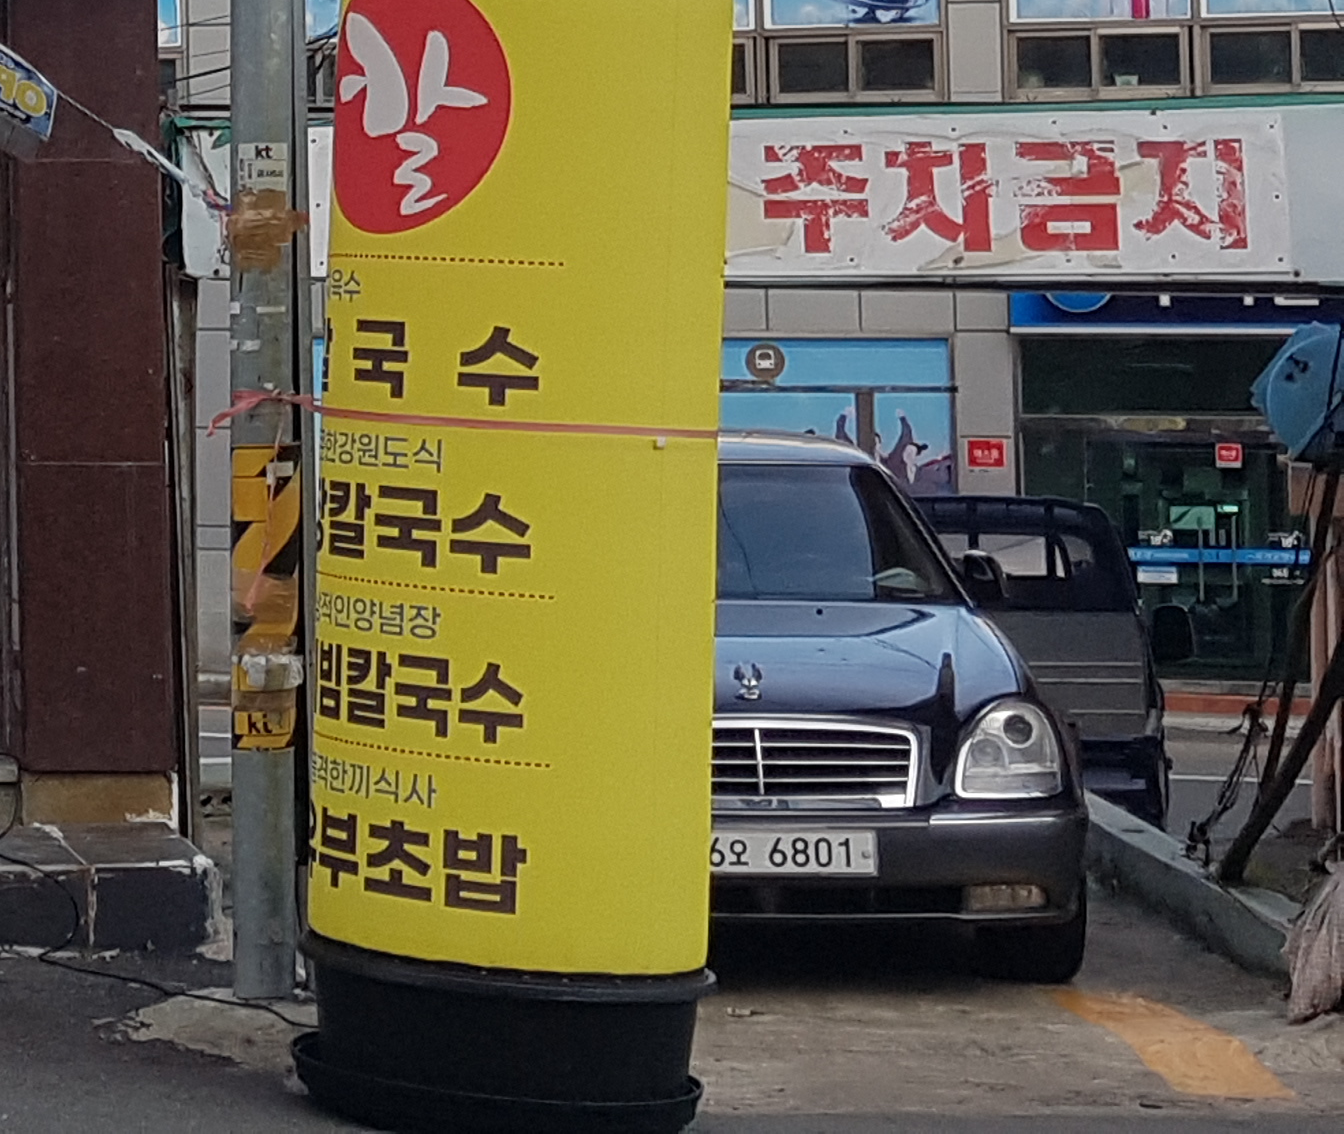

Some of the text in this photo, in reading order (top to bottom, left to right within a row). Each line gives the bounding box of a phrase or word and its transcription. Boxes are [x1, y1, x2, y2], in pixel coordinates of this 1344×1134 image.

[255, 145, 273, 159] kt
[321, 317, 539, 406] 국수
[320, 429, 443, 474] 한강원도식
[316, 592, 441, 639] 적인양념장
[315, 638, 524, 743] 빔칼국수
[311, 752, 437, 809] 격한끼식사
[310, 799, 527, 914] 부초밥
[769, 837, 851, 867] 6801
